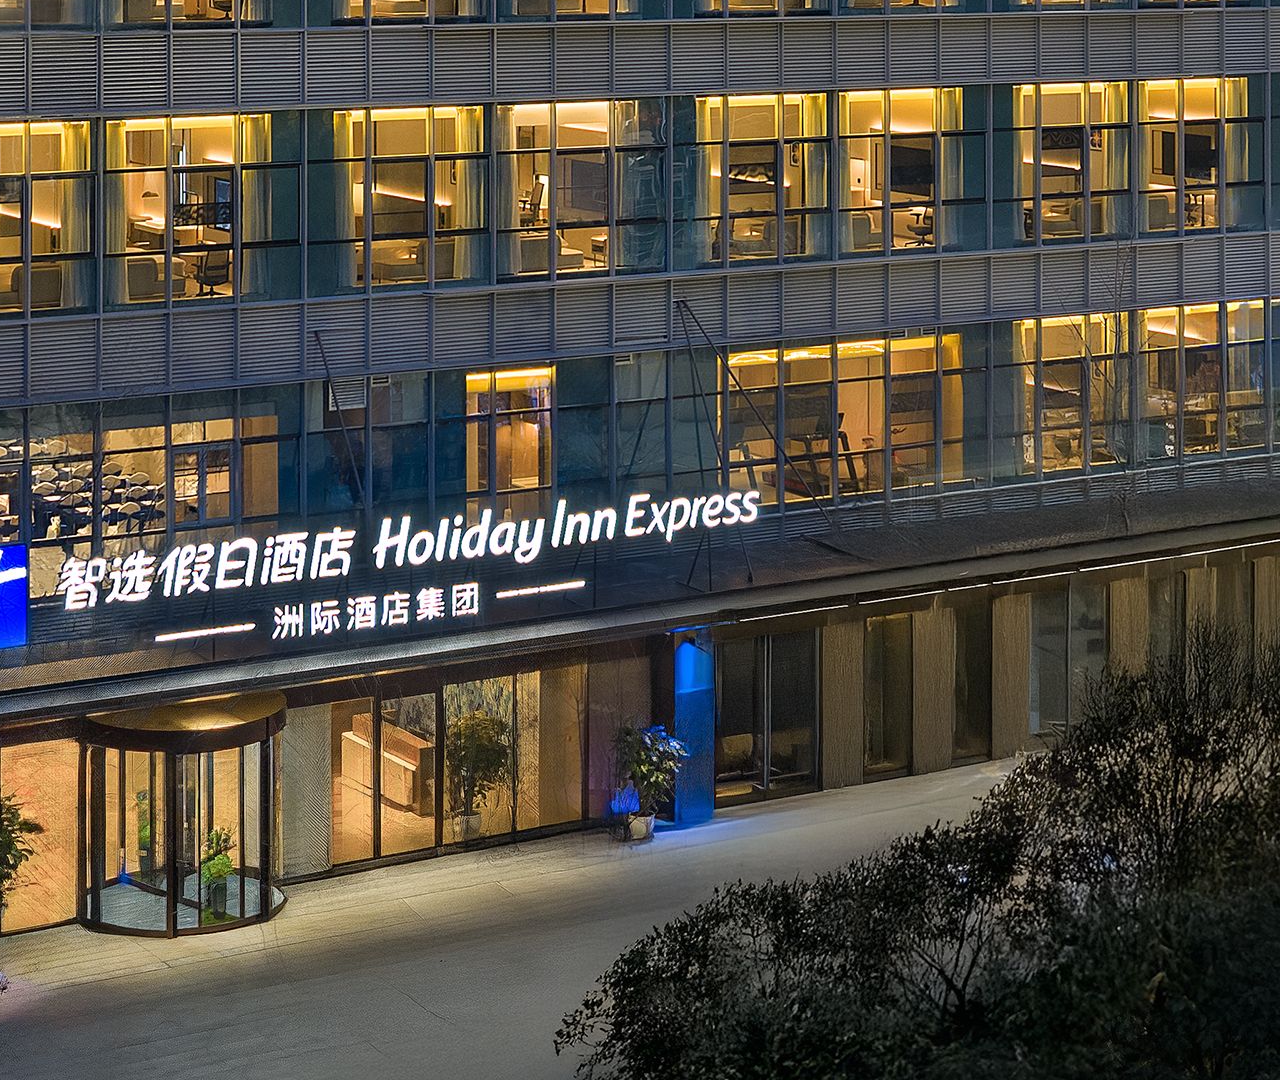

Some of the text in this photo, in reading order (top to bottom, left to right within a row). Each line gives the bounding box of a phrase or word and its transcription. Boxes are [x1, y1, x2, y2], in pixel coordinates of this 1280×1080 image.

[56, 490, 760, 610] 智选假日酒店 Holiday Inn Express
[271, 582, 479, 640] 洲际酒店集团
